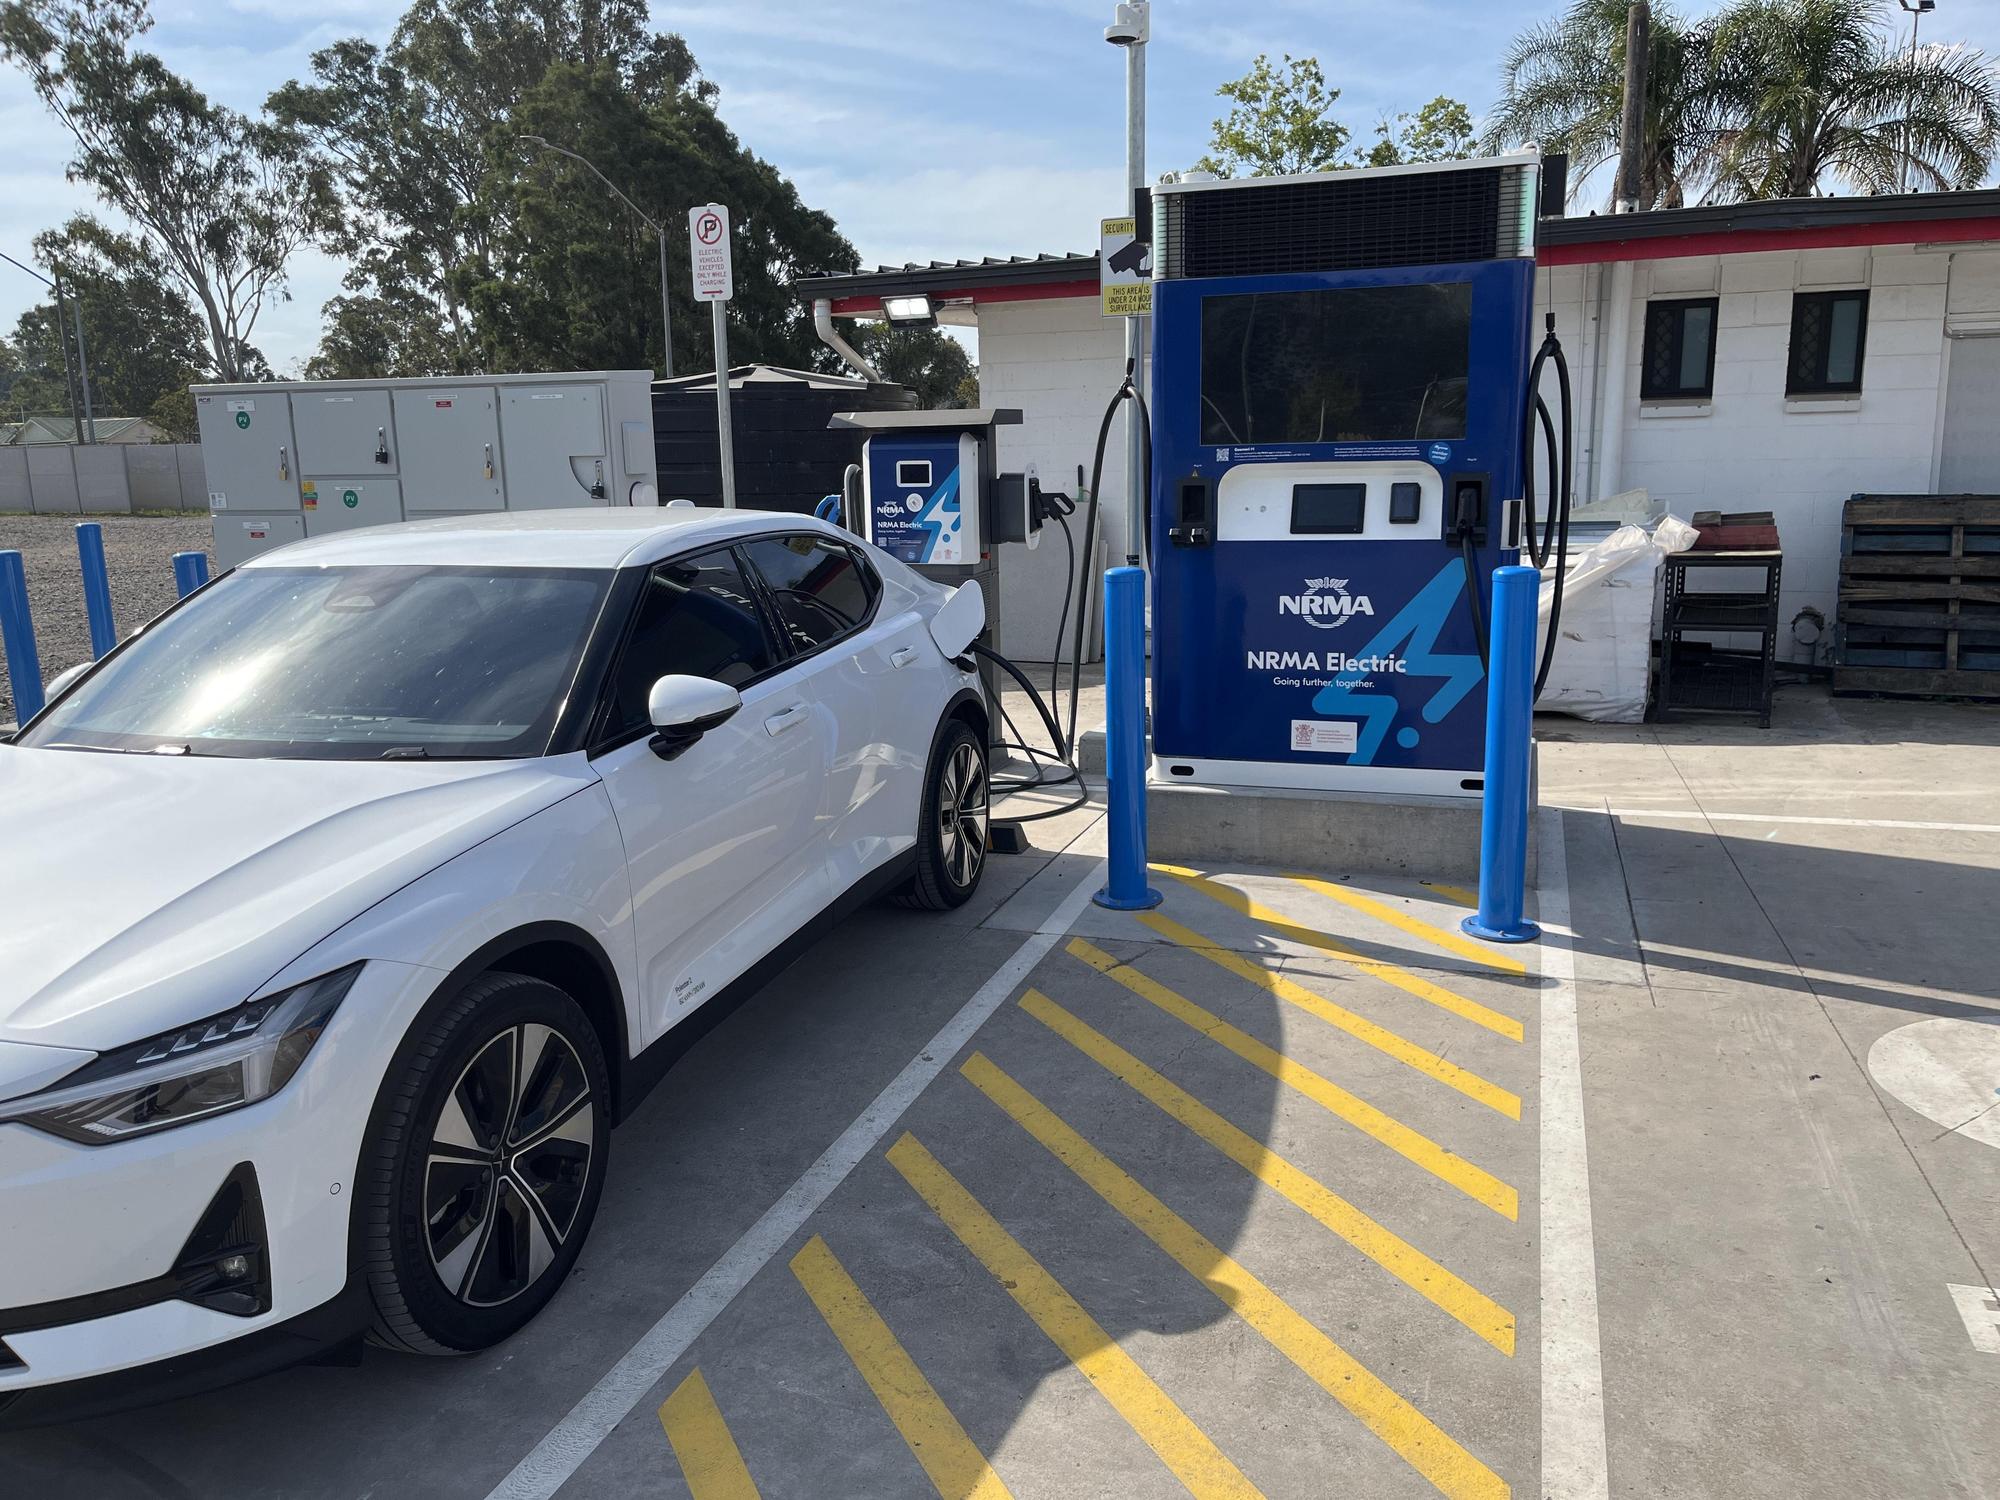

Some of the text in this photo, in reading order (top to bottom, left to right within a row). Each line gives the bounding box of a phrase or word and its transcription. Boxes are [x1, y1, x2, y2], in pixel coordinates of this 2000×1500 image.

[1105, 222, 1134, 234] SECURITY
[1112, 286, 1150, 296] THIS AREA IS
[1108, 295, 1128, 304] UNDER
[1128, 295, 1137, 303] 24
[1109, 302, 1152, 313] SURVEILLANCE
[345, 495, 355, 503] PV
[877, 506, 904, 514] NRMA
[1279, 595, 1375, 616] NRMA
[1247, 650, 1407, 673] NRMA Electric
[1273, 676, 1375, 689] Going further, together.
